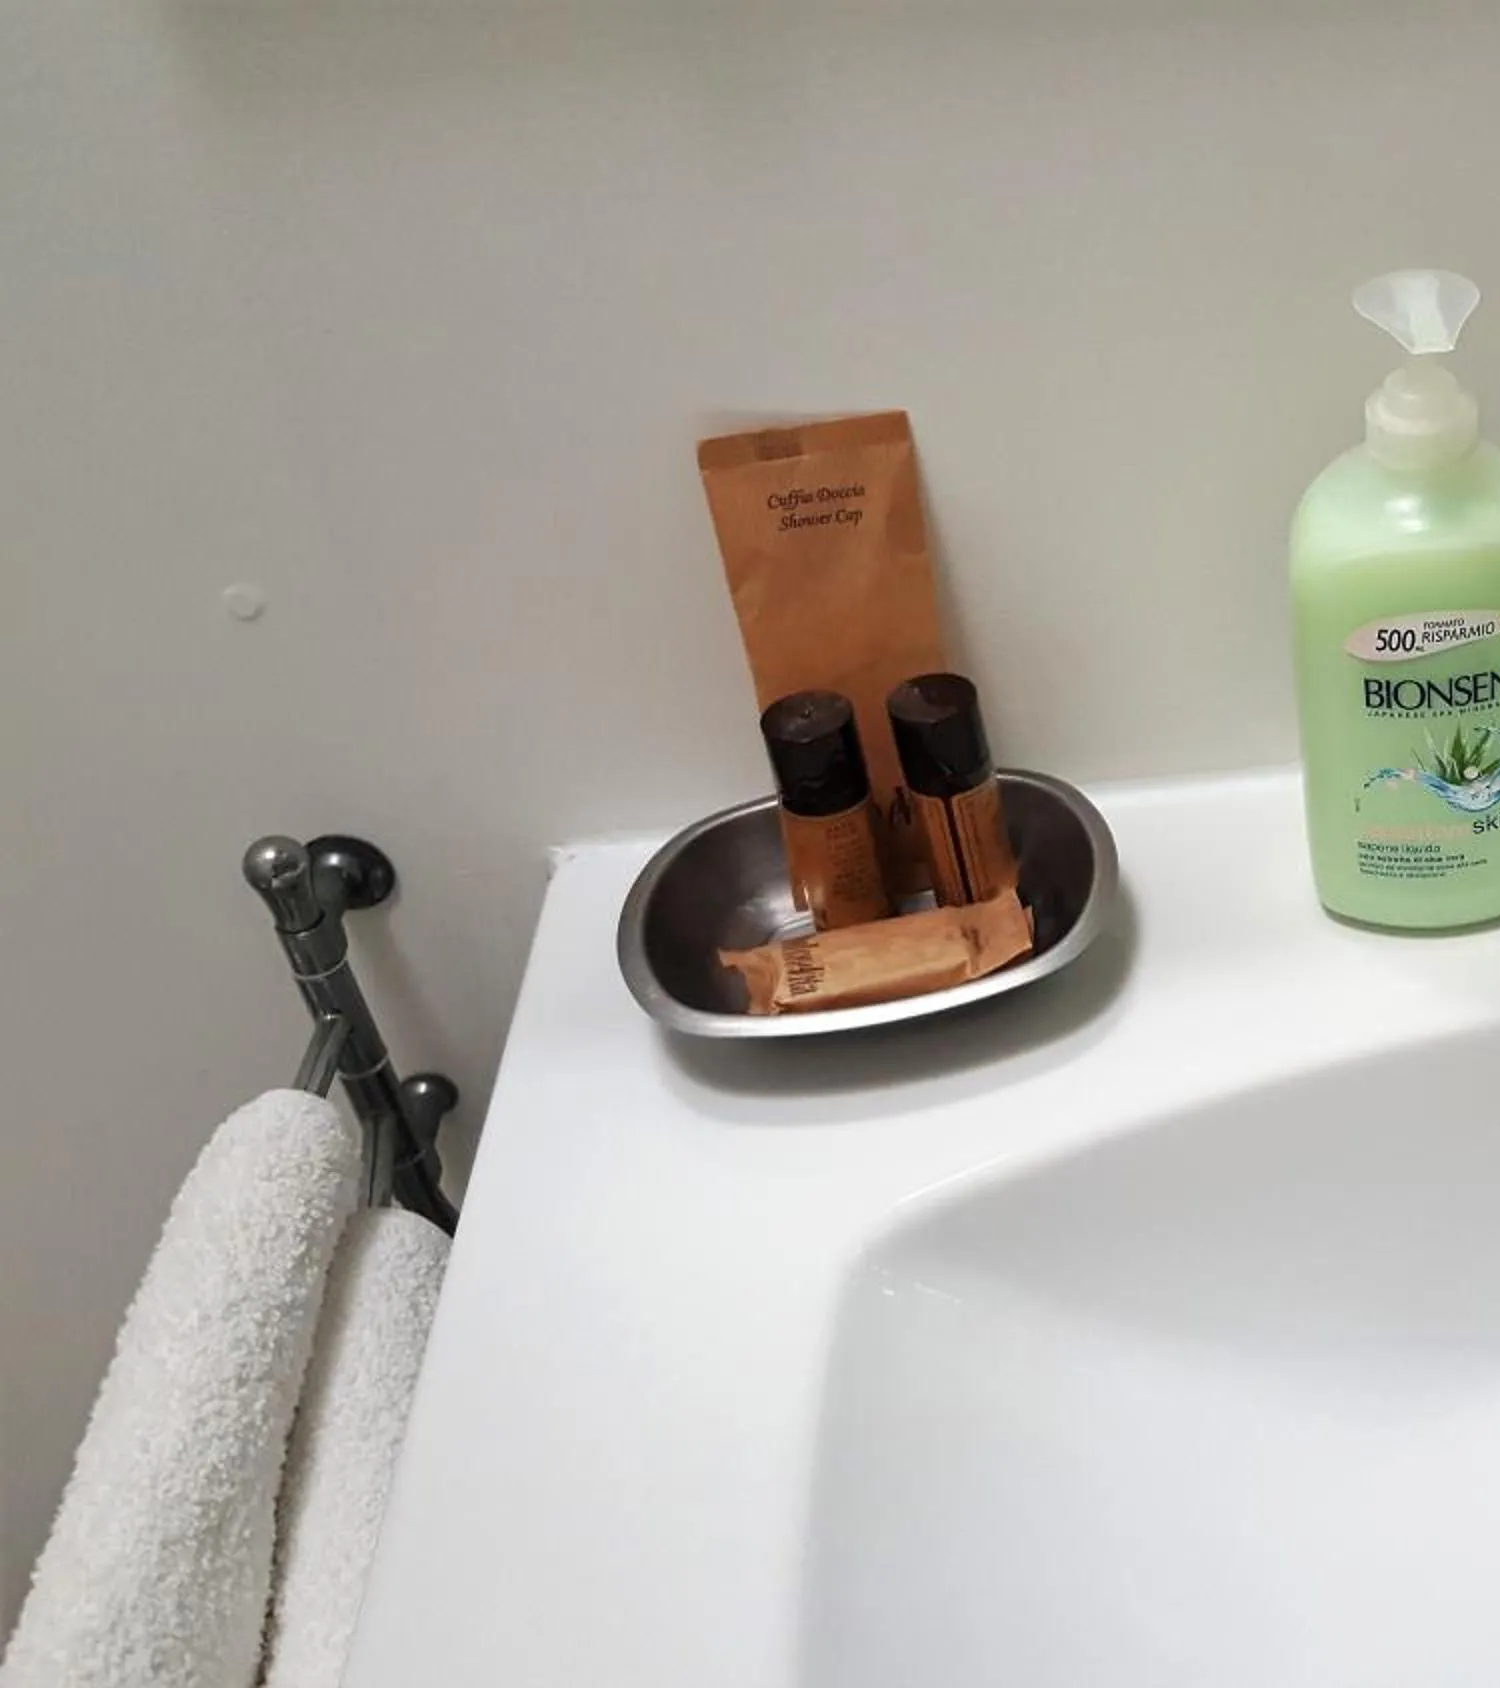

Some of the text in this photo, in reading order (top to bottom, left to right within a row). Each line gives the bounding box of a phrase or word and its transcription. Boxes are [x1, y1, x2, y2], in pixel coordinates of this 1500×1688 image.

[767, 485, 865, 510] Cuffia Doccia
[778, 509, 862, 531] Shower Cap
[1423, 618, 1465, 630] FORMATO
[1375, 629, 1416, 652] 500
[1421, 621, 1495, 643] RISPARMIO
